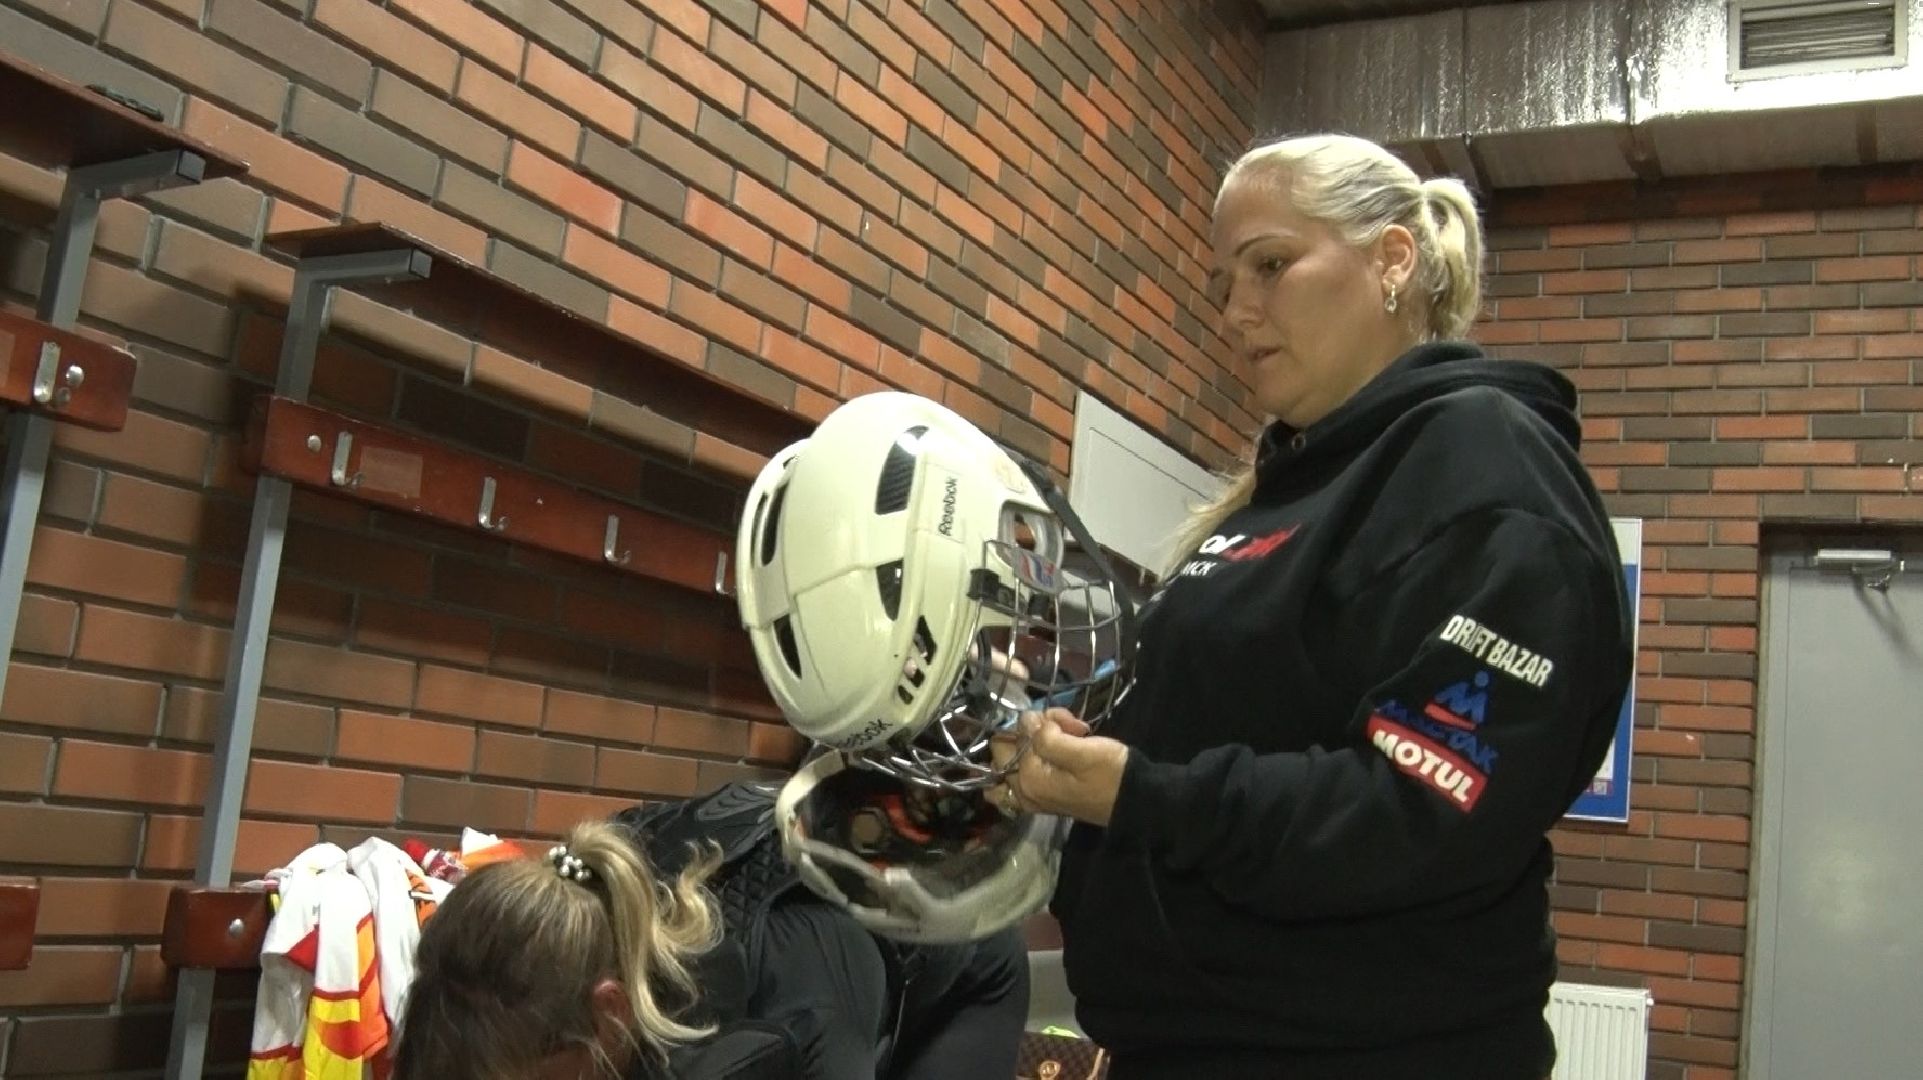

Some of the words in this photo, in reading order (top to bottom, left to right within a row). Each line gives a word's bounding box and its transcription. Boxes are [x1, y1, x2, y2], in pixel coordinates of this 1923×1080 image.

[938, 476, 957, 537] Reebok
[1440, 614, 1498, 658] DRIFT
[1486, 638, 1554, 687] BAZAR
[1373, 729, 1474, 803] MOTUL
